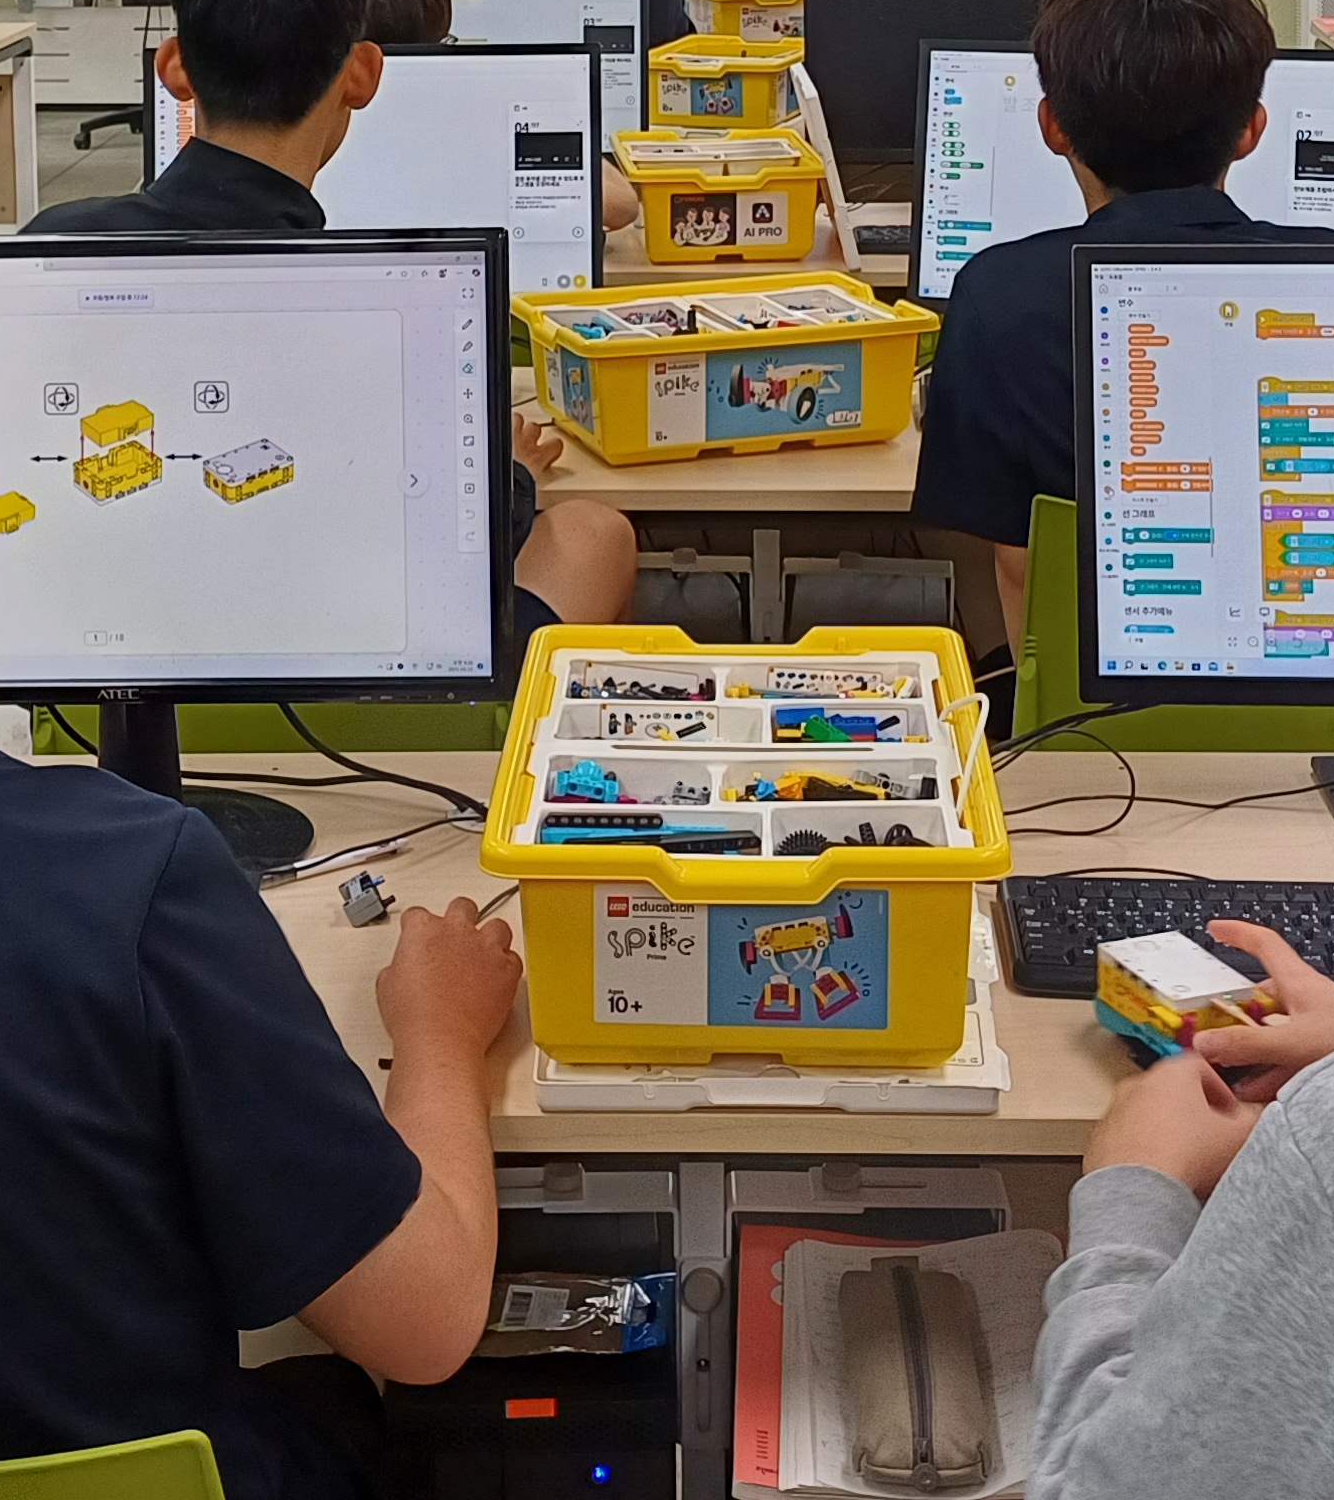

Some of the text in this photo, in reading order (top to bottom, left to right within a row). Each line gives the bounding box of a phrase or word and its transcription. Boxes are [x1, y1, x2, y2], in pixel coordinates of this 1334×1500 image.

[515, 122, 529, 133] 04
[1296, 130, 1312, 141] 02
[744, 227, 783, 237] AI PRO
[1118, 298, 1134, 308] 변수
[1122, 509, 1156, 519] 선 그래프
[97, 688, 140, 700] ATEC
[609, 901, 695, 913] LEGO education
[646, 953, 667, 961] Prime
[608, 996, 643, 1014] 10+
